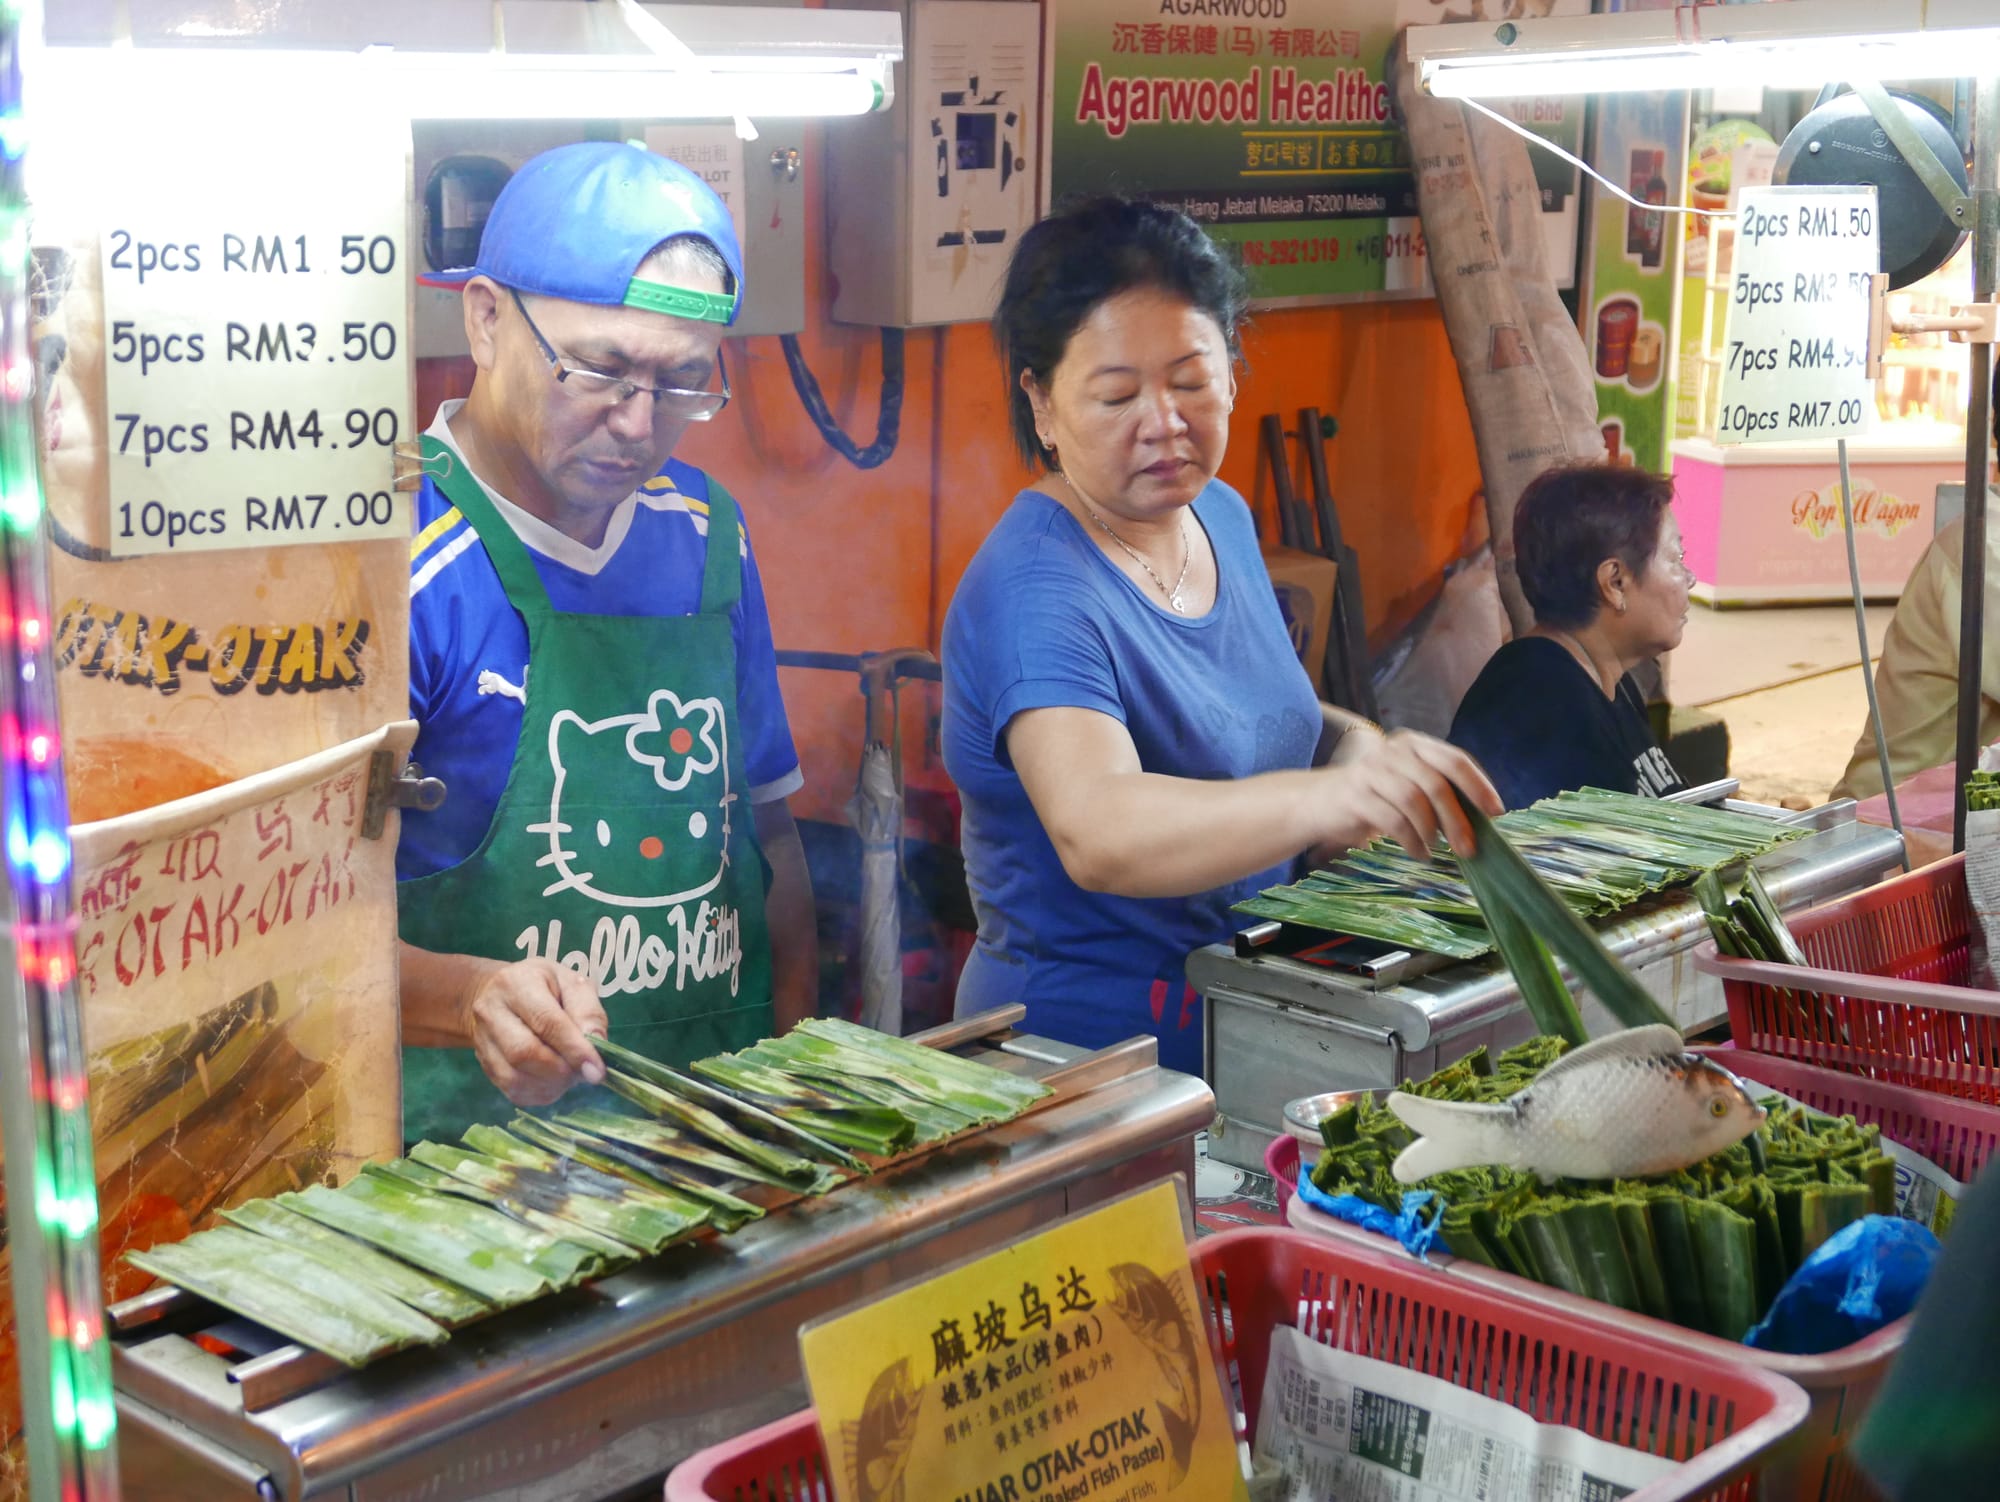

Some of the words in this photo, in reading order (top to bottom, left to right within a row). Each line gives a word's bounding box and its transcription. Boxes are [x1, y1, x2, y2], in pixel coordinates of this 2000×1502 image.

[1160, 0, 1287, 18] AGARWOOD
[1076, 64, 1261, 137] Agarwood
[1270, 67, 1397, 123] Healthc
[704, 169, 731, 182] LOT
[1184, 198, 1219, 220] Hang
[1222, 197, 1257, 216] Jebat
[1260, 196, 1304, 215] Melaka
[1307, 194, 1345, 213] 75200
[1346, 193, 1386, 212] Melaka
[1742, 205, 1789, 247] 2pcs
[1798, 206, 1872, 238] RM1.50
[110, 229, 201, 284] 2pcs
[1735, 272, 1784, 314] 5pcs
[1793, 271, 1872, 303] RM350
[111, 321, 205, 375] 5pcs
[225, 321, 397, 363] RM3.50
[1729, 340, 1778, 381] 7pcs
[114, 413, 209, 466] 7pcs
[230, 407, 399, 451] RM4.90
[1720, 404, 1779, 438] 10pcs
[1787, 399, 1862, 428] RM7.00
[117, 500, 227, 547] 10pcs
[245, 490, 393, 532] RM7.00
[1791, 490, 1837, 528] Pop
[1852, 489, 1921, 527] Wagon
[55, 596, 370, 697] OTAK-OTAK
[667, 899, 743, 998] Kitty
[931, 1266, 1097, 1379] 麻坡乌达
[1022, 1407, 1151, 1493] OTAK-OTAK
[1091, 1460, 1121, 1491] Fish
[1121, 1436, 1165, 1476] Paste)
